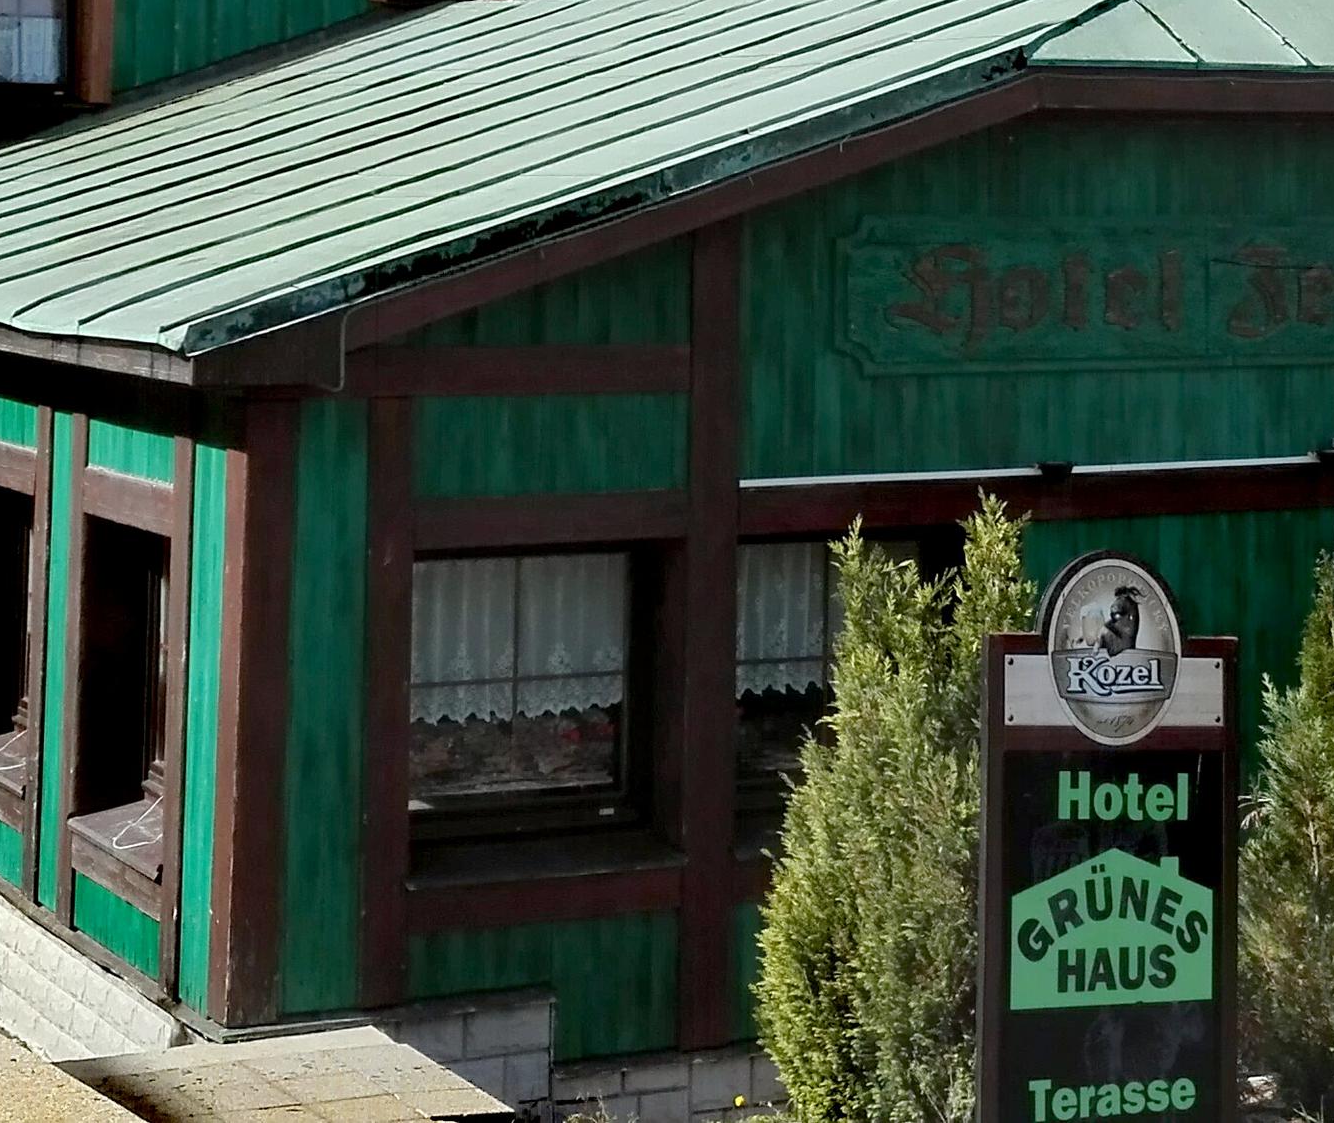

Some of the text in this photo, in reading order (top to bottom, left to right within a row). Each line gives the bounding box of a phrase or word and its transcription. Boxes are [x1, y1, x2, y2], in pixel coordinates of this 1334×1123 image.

[886, 242, 1184, 355] Hotel
[1067, 656, 1165, 697] Kozel
[1058, 770, 1189, 822] Hotel
[1017, 863, 1209, 962] GRÜNES
[1057, 944, 1177, 994] HAUS
[1028, 1077, 1197, 1123] Terasse
